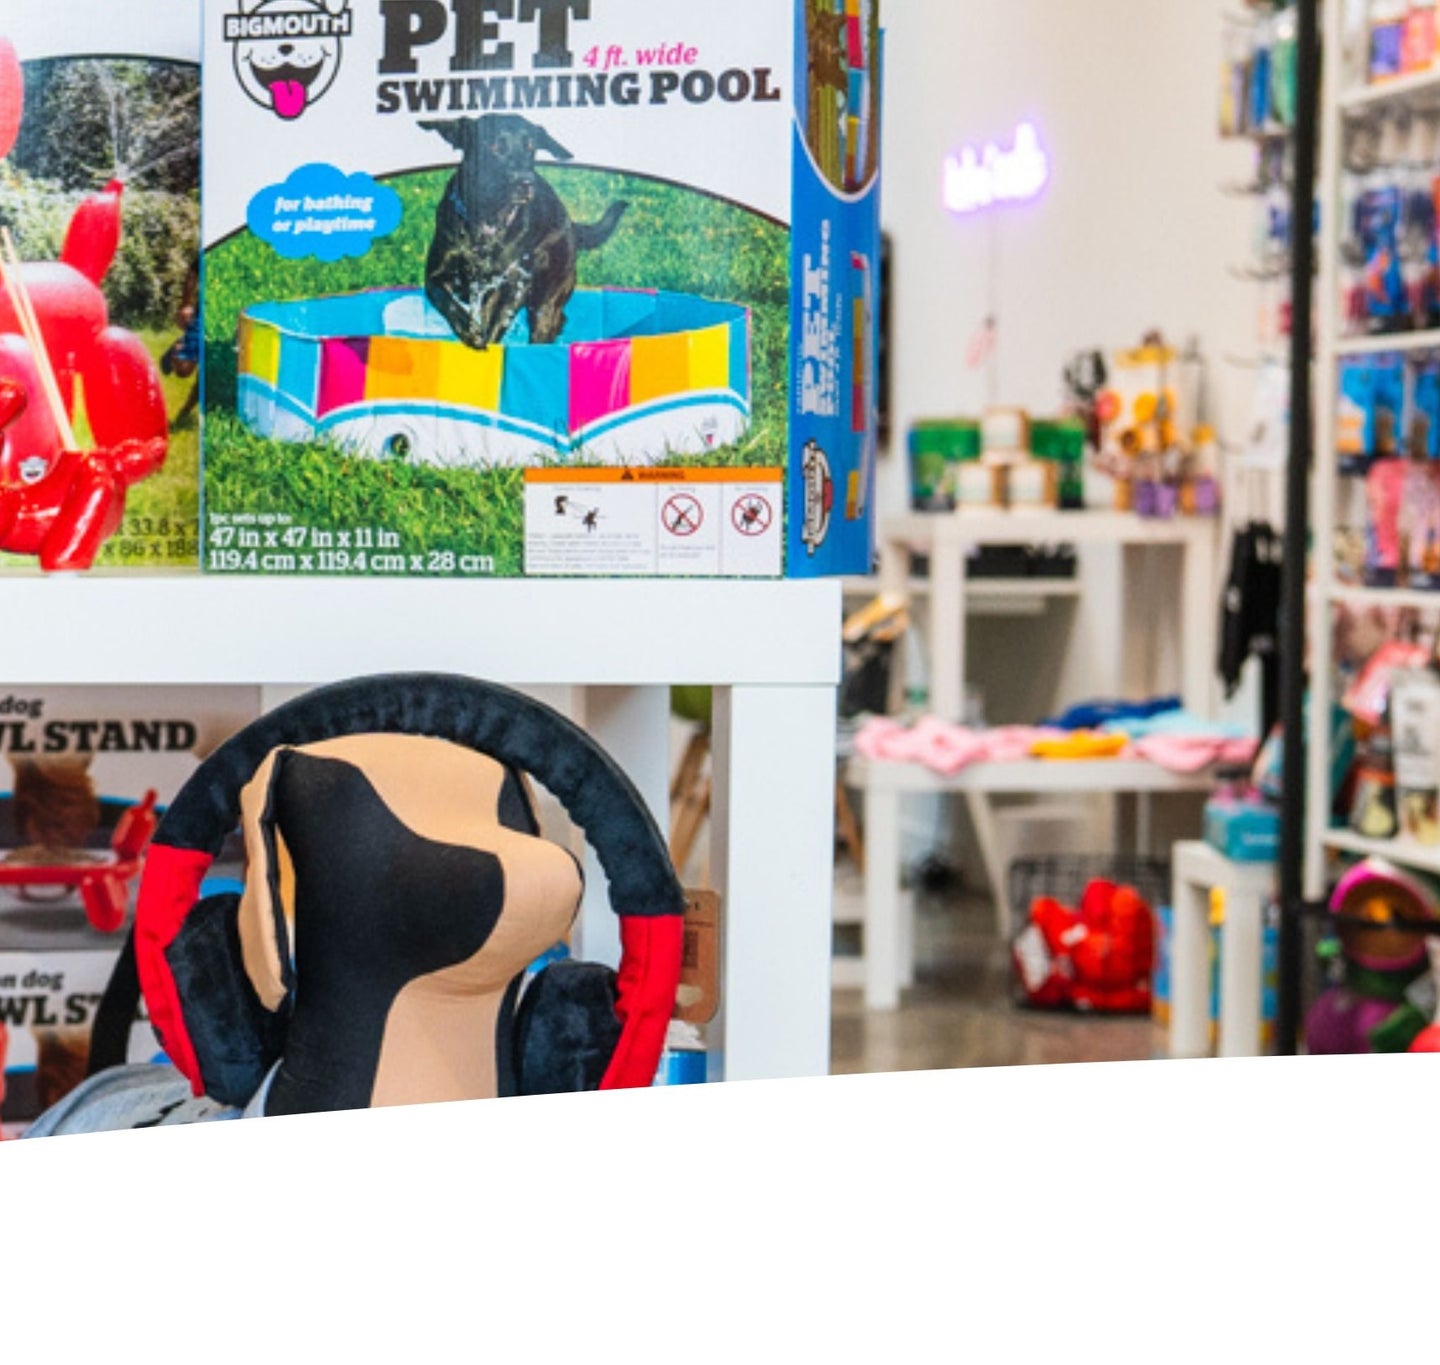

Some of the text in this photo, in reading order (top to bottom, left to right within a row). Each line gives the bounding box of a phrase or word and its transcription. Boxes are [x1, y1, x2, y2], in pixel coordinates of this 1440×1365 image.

[226, 14, 350, 38] BIGMOUTH
[377, 0, 590, 74] PET
[582, 42, 699, 71] 4 ft. wide
[376, 68, 781, 114] SWIMMING POOL
[274, 194, 374, 215] for bathing
[272, 215, 377, 236] or playtime
[209, 526, 400, 548] 47 in x 47 in x 11 in
[209, 550, 495, 571] 119.4 cm x 119.4 cm x 28 cm
[43, 719, 197, 751] STAND
[21, 970, 65, 993] dog
